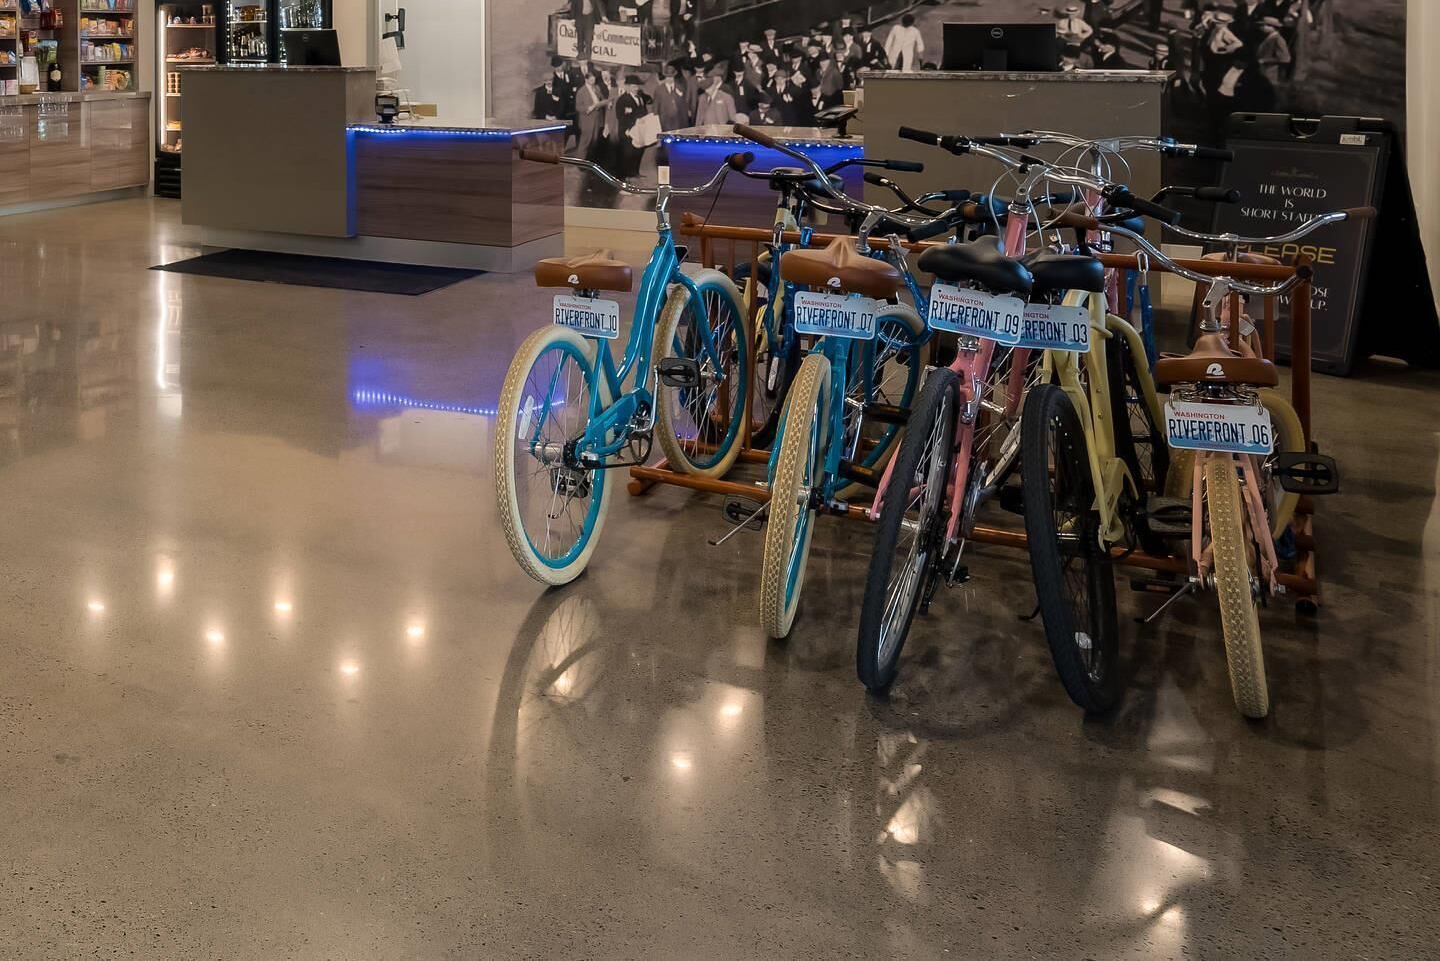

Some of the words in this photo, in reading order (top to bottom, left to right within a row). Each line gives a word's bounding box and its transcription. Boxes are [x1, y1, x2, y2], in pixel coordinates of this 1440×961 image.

[572, 43, 617, 57] SCIAL
[1259, 184, 1276, 195] THE
[1281, 186, 1327, 199] WORLD
[1285, 199, 1295, 208] IS
[1240, 207, 1277, 220] SHORT
[560, 302, 592, 310] WASHINGTON
[801, 299, 842, 309] WASHINGTON
[938, 293, 984, 307] WASHINGTON
[555, 308, 605, 330] RIVERFRONT
[608, 314, 617, 332] 10
[796, 306, 857, 330] RIVERFRONT
[860, 313, 874, 331] 07
[931, 300, 1000, 331] RIVERFRONT
[1005, 314, 1019, 335] 09
[1023, 312, 1050, 320] INGTON
[1021, 319, 1067, 342] ERFRONT
[1072, 323, 1088, 344] 03
[1173, 411, 1225, 420] WASHINGTON
[1168, 418, 1246, 444] RIVERFRONT
[1252, 424, 1269, 445] 06
